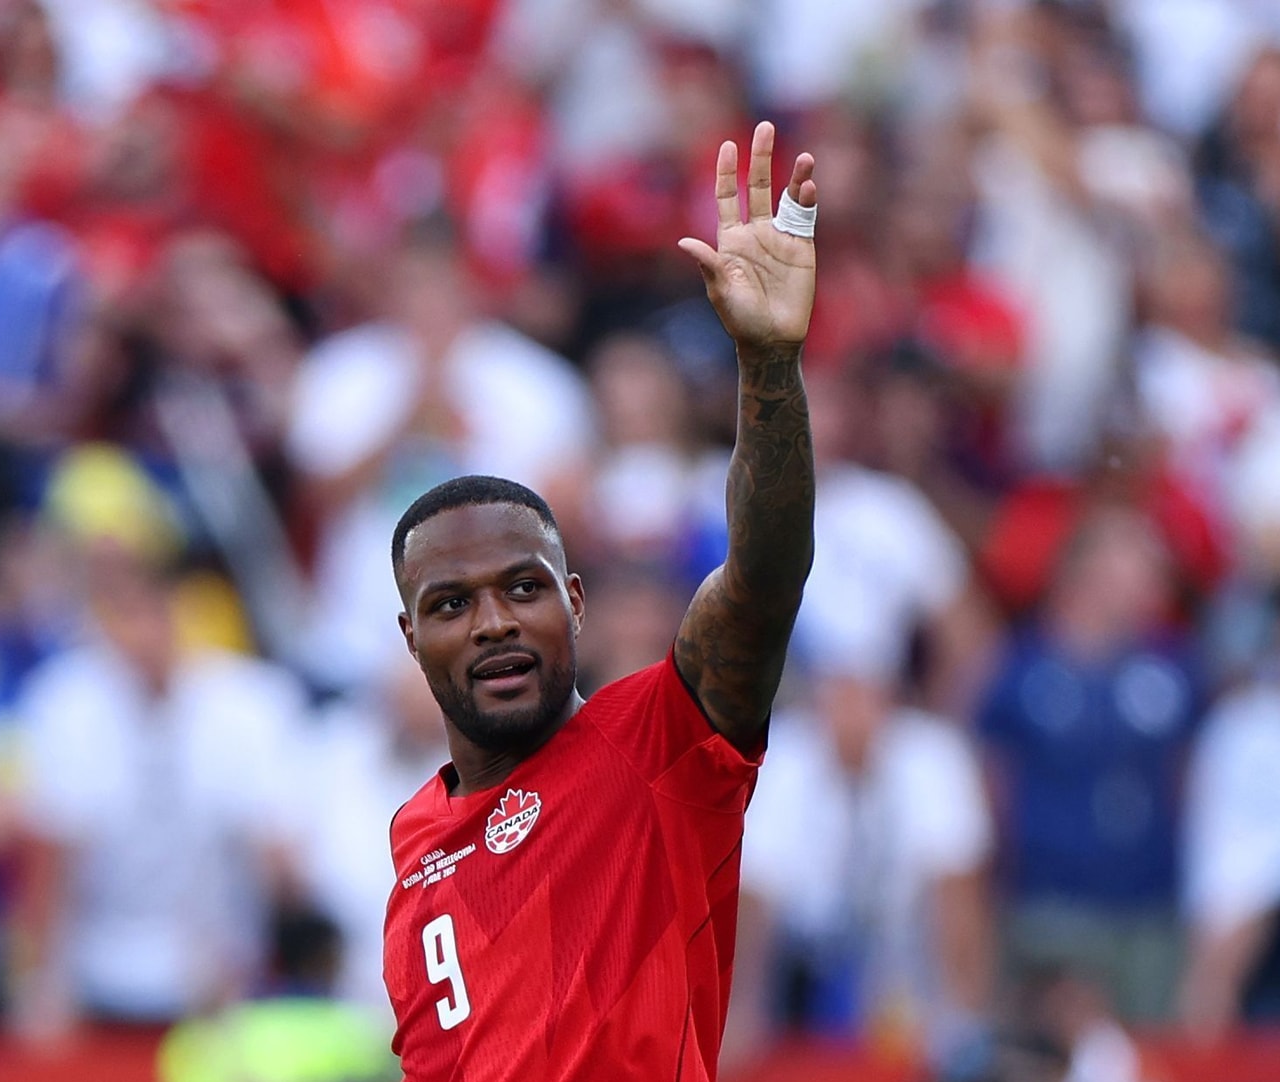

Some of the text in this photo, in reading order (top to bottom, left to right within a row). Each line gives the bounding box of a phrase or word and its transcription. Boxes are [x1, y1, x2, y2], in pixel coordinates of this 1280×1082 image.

[486, 806, 538, 839] CANADA
[420, 848, 446, 865] CANADA
[402, 871, 424, 889] BOSNIA
[422, 913, 471, 1031] 9
